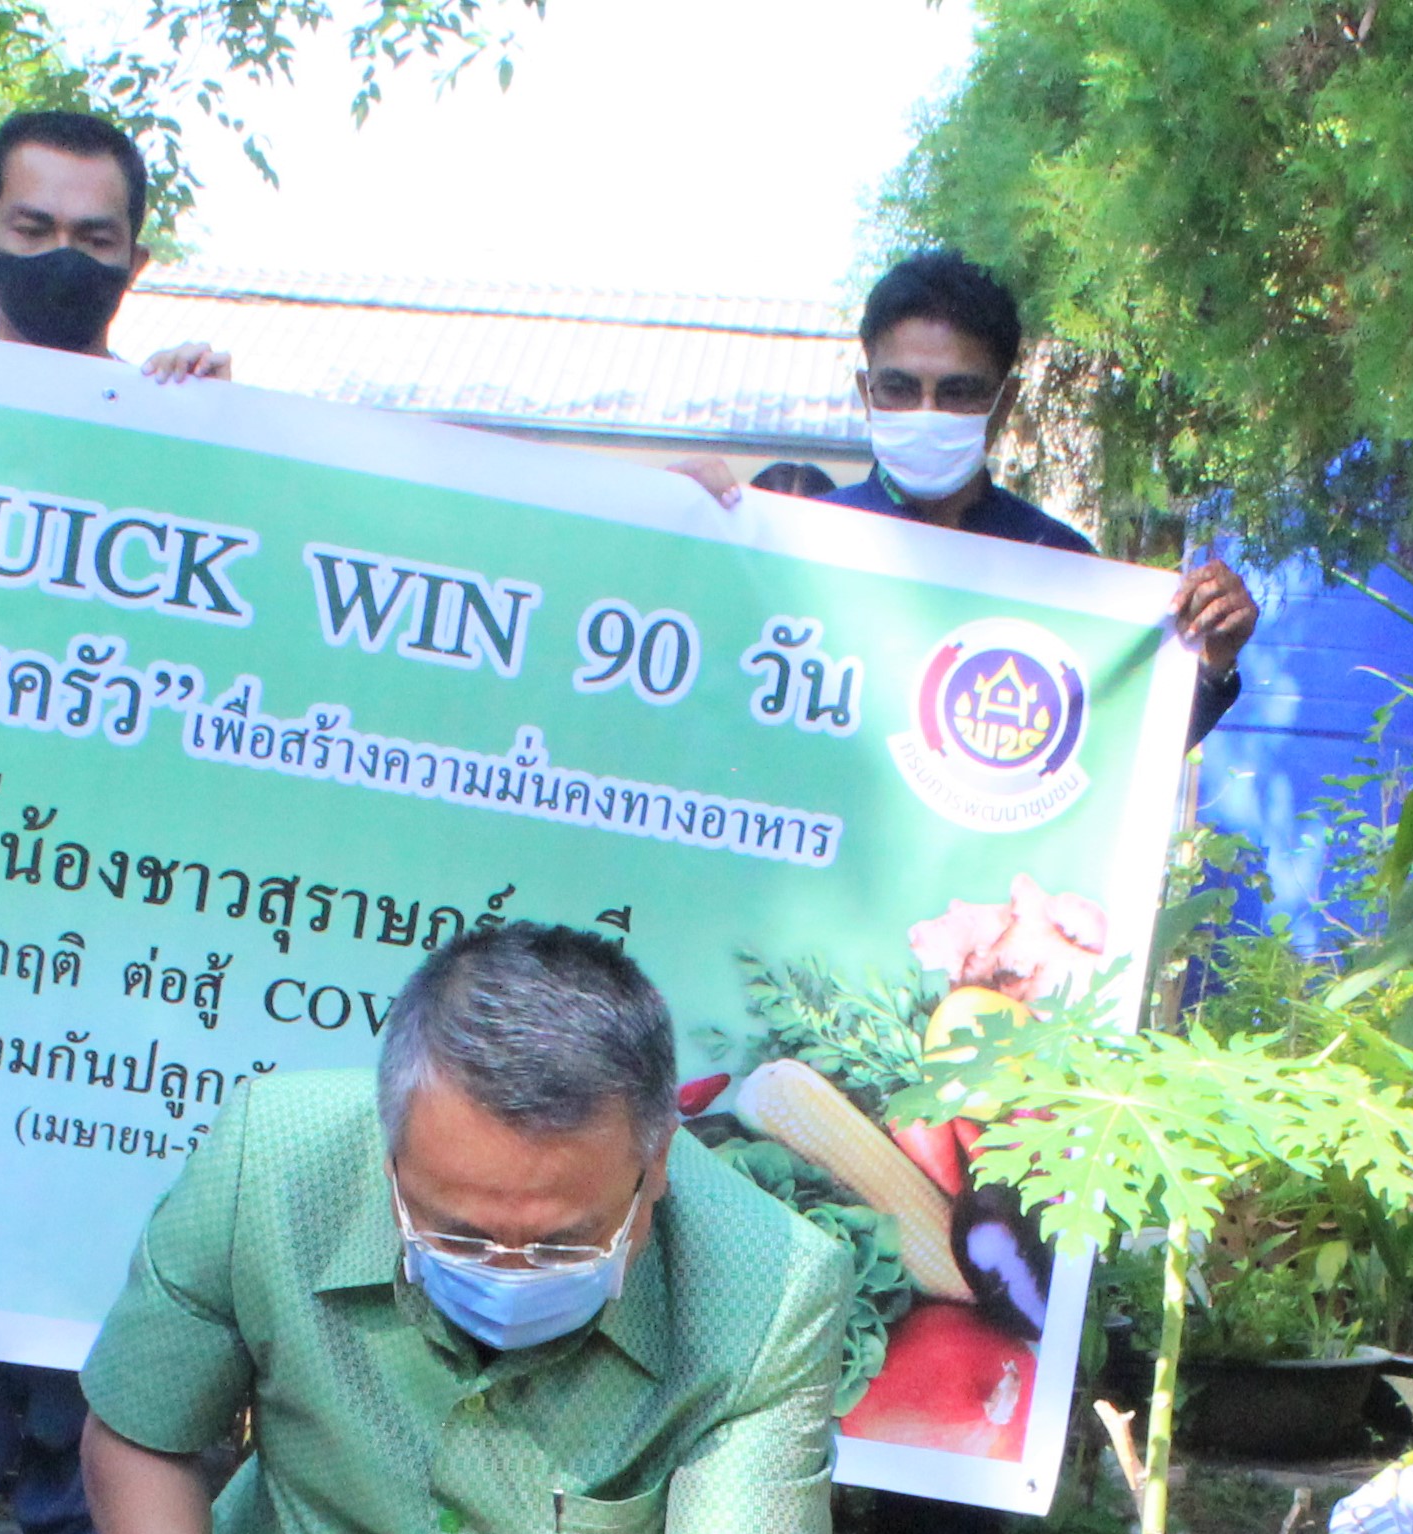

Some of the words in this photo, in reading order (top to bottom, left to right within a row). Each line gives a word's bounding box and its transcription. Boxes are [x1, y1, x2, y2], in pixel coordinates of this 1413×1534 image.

[312, 551, 532, 669] WIN
[584, 607, 692, 697] 90
[750, 625, 854, 728] วัน
[192, 685, 834, 859] เพื่อสร้างความมั่นคงทางอาหาร
[122, 946, 234, 1030] ต่อสู้
